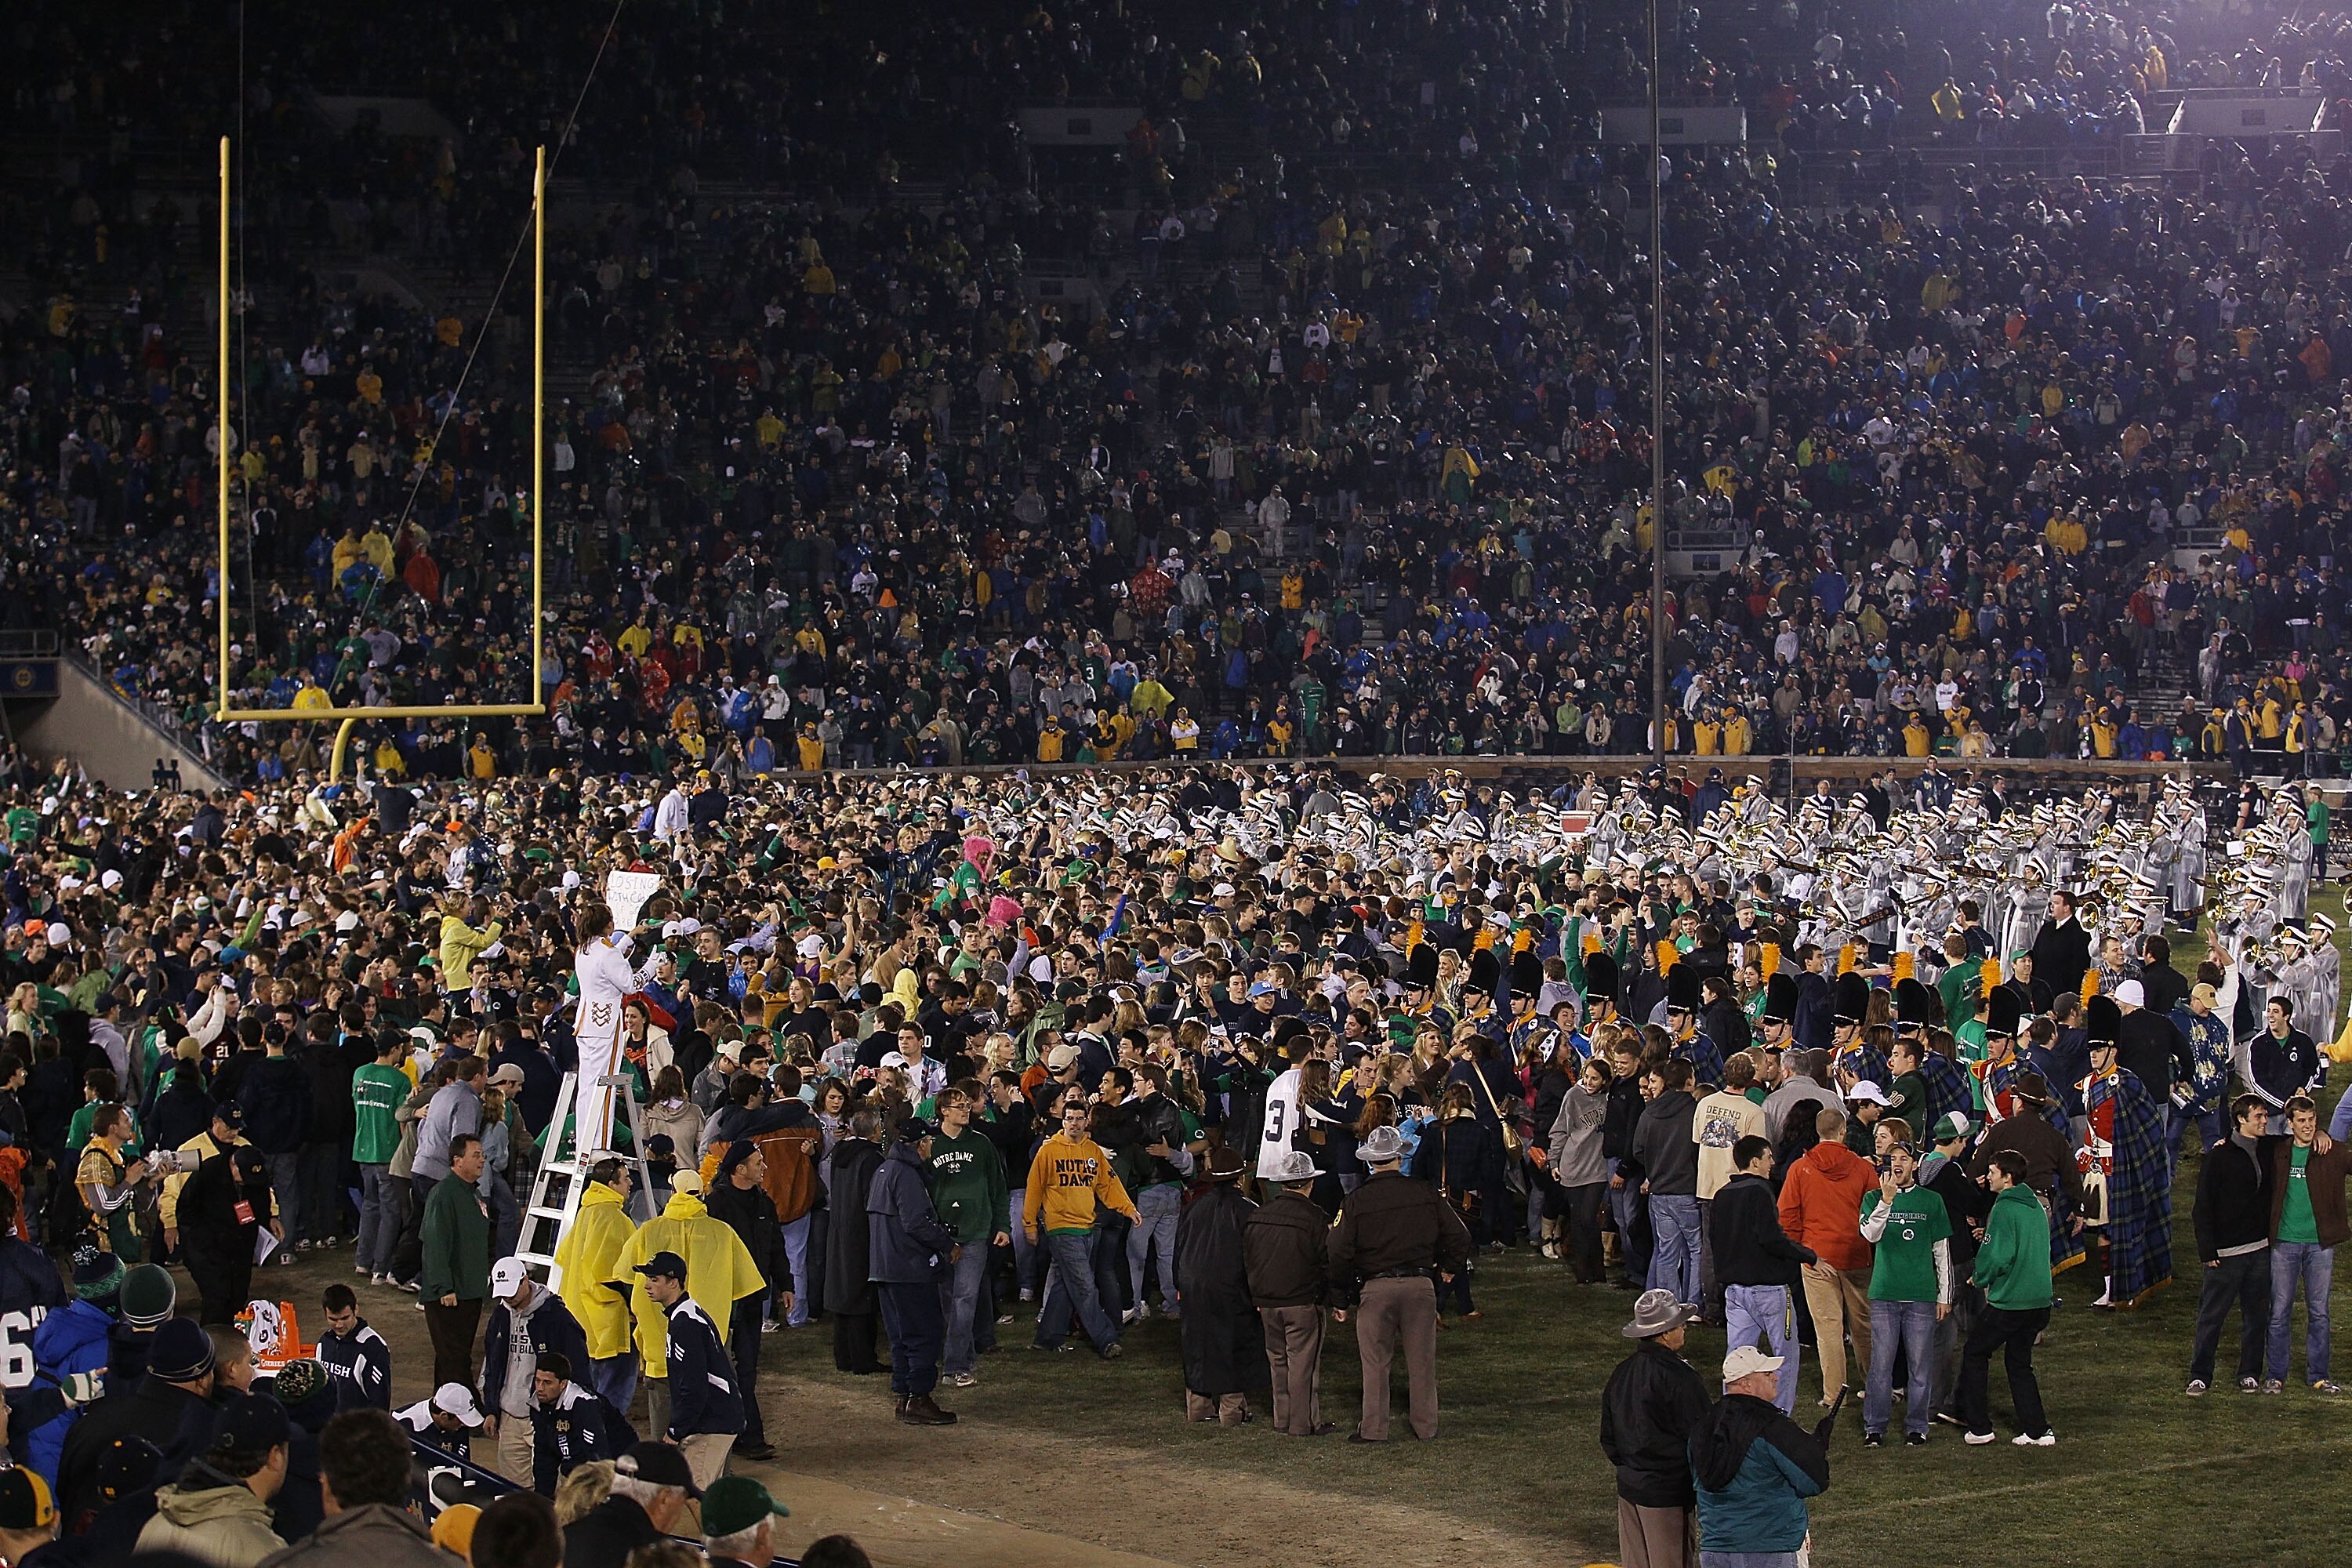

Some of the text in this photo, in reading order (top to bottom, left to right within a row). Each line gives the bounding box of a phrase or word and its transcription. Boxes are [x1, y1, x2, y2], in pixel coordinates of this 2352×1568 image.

[1702, 556, 1710, 569] 4
[824, 602, 832, 614] 7
[1086, 668, 1094, 680] 3
[1843, 715, 1851, 727] 7
[2253, 798, 2265, 816] 41
[611, 873, 655, 890] LOSING
[216, 1045, 230, 1058] 21
[1886, 1091, 1905, 1108] 10
[1707, 1105, 1741, 1120] DEFEND
[1265, 1099, 1285, 1142] 3
[932, 1152, 954, 1168] NOTRE
[955, 1152, 974, 1162] DAME
